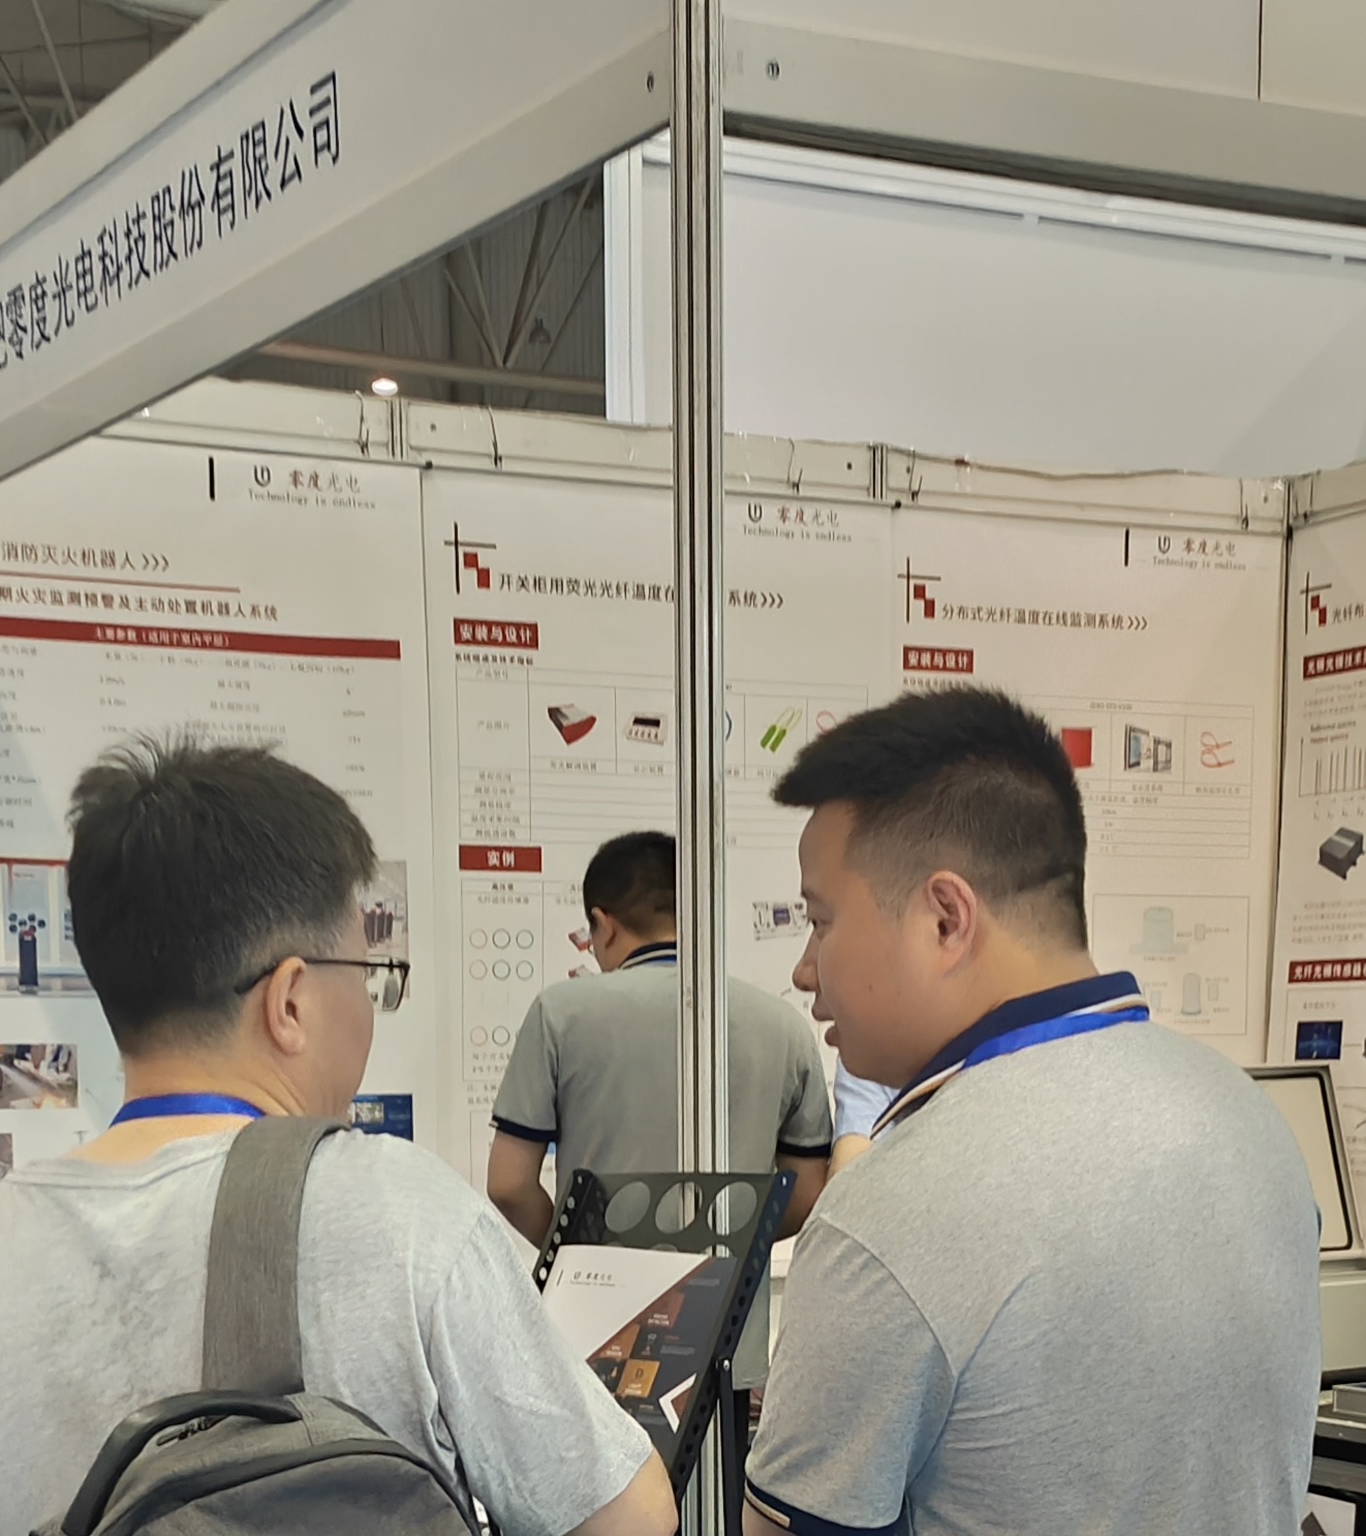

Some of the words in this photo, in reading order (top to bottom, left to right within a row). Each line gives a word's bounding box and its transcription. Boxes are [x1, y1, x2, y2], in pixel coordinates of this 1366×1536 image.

[941, 603, 1125, 631] 分布式光纤温度在线监测系统
[459, 622, 532, 645] 安装与设计
[487, 850, 516, 868] 实例
